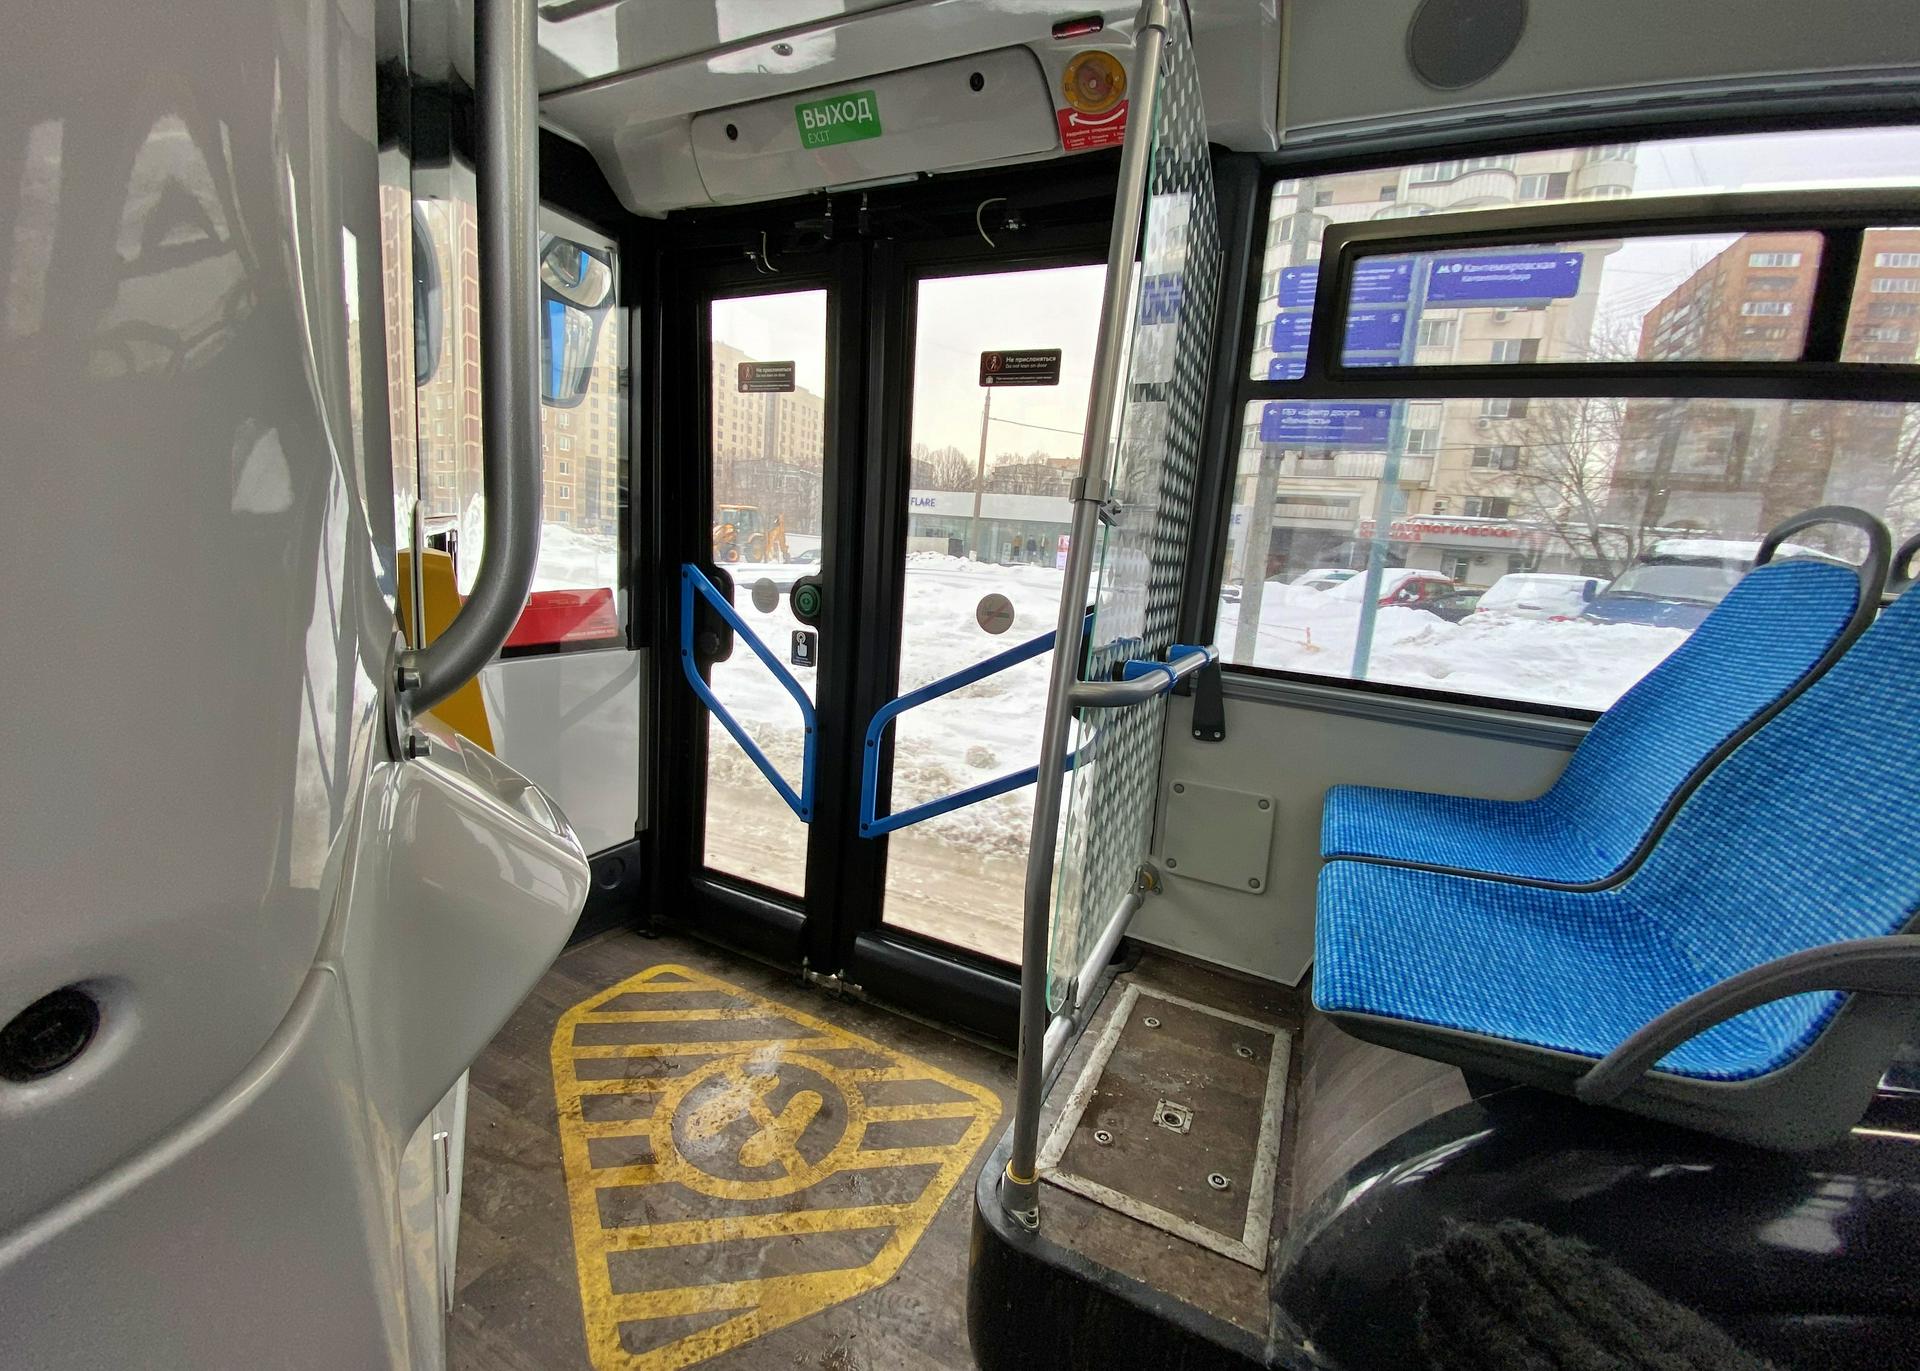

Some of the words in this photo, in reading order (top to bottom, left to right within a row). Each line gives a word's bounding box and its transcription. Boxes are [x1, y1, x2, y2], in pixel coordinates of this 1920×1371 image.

[802, 97, 873, 129] ВЫХОД
[807, 130, 830, 144] EXIT
[1463, 261, 1557, 273] Кантемировская
[910, 497, 936, 507] FLARE
